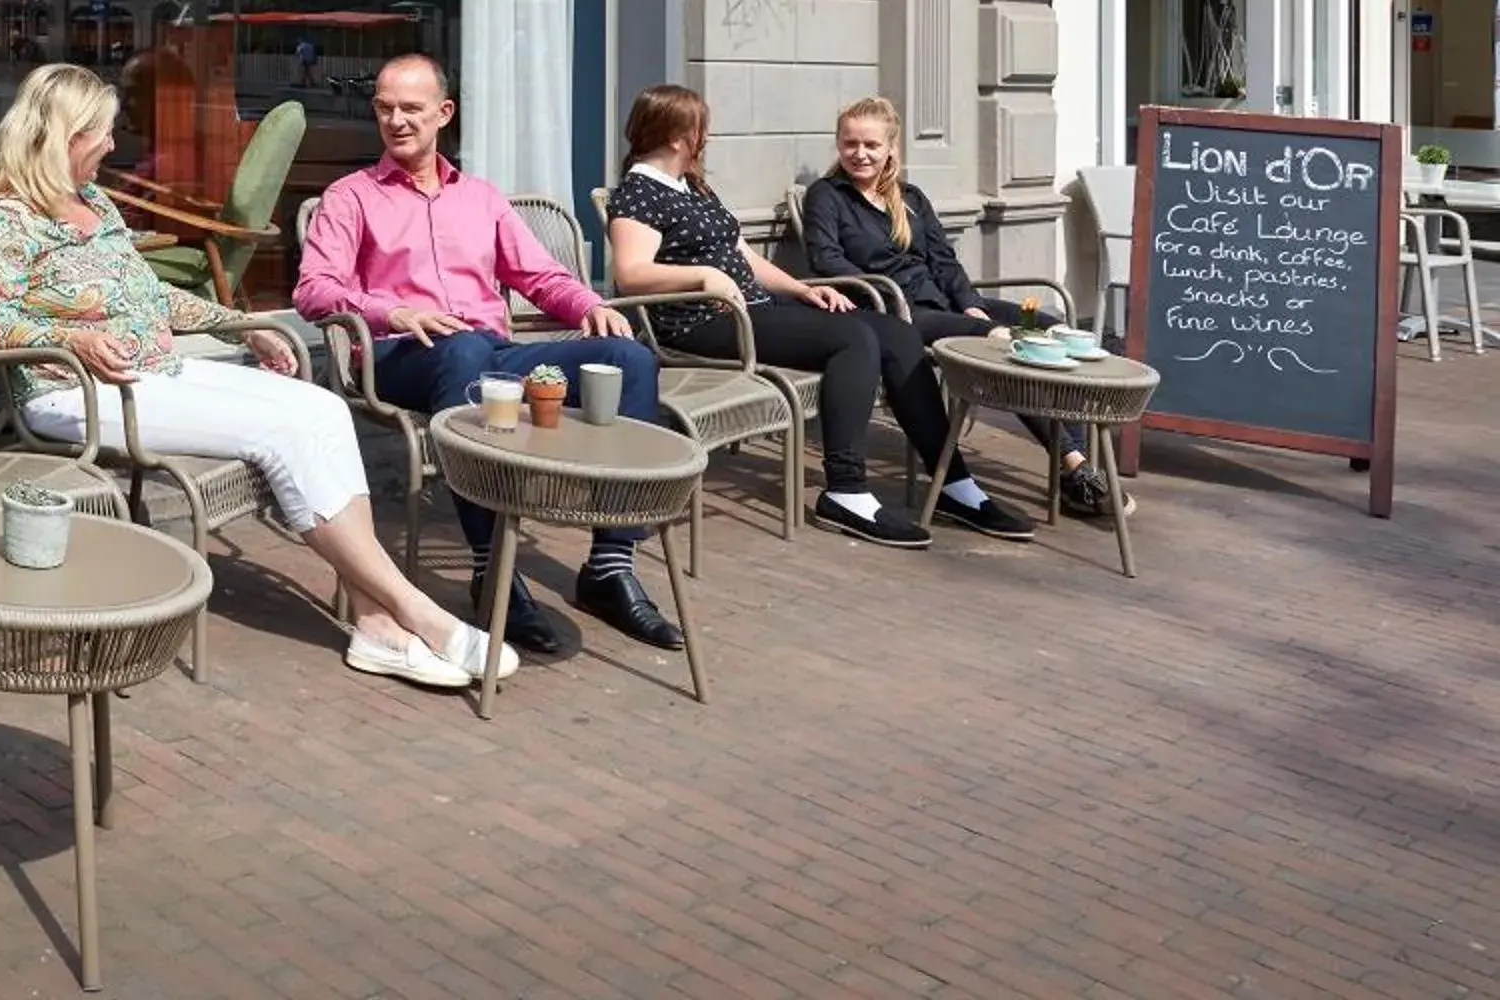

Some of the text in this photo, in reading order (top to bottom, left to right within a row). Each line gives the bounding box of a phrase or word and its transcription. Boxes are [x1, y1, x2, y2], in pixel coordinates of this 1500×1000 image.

[1185, 180, 1331, 211] Visit our
[1167, 204, 1368, 255] Café Lounge
[1188, 244, 1202, 257] a
[1209, 241, 1269, 265] drink,
[1277, 247, 1353, 271] coffee,
[1181, 286, 1314, 310] snacks or
[1231, 313, 1314, 336] wines
